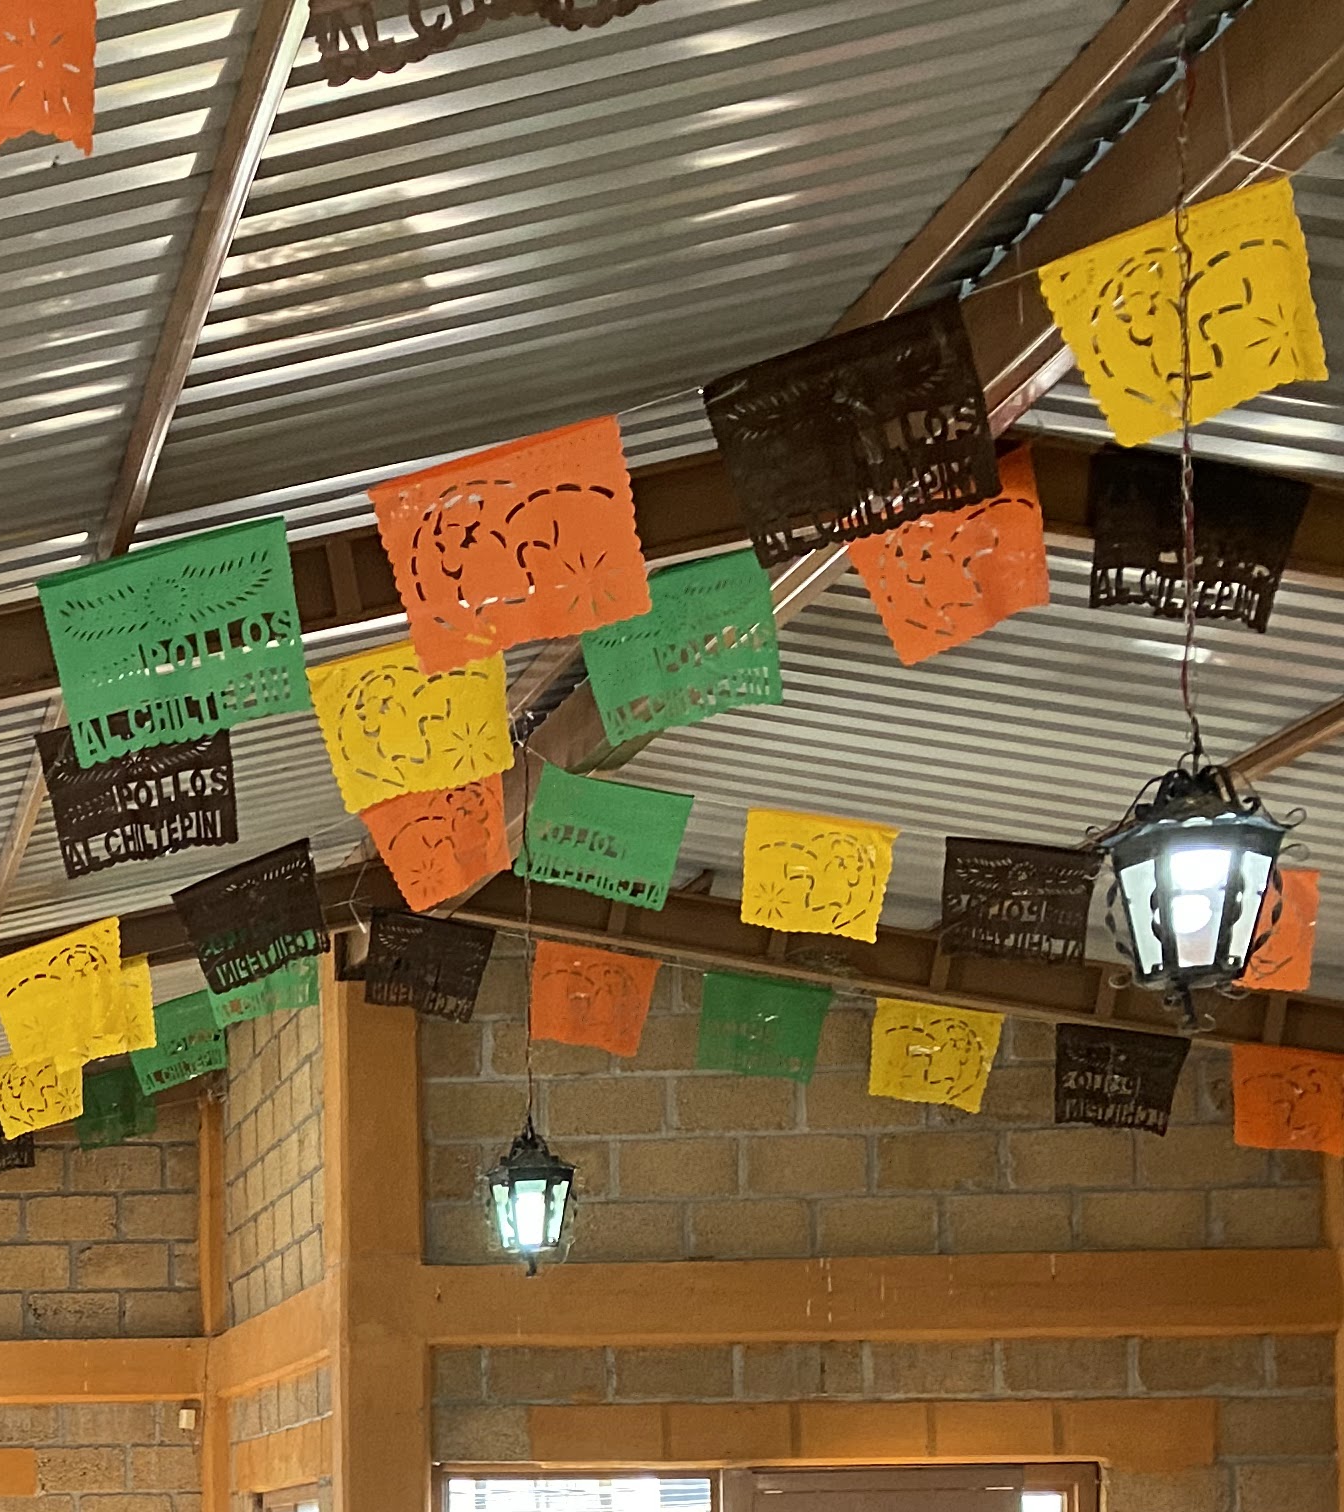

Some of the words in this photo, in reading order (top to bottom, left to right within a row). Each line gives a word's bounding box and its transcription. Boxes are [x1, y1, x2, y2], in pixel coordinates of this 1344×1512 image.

[143, 611, 293, 673] POLLOS
[78, 715, 125, 757] AL
[128, 668, 291, 738] CHILTEPIN
[114, 765, 229, 813] POLLOS
[65, 838, 101, 871] AL
[105, 809, 219, 858] CHILTEPIN
